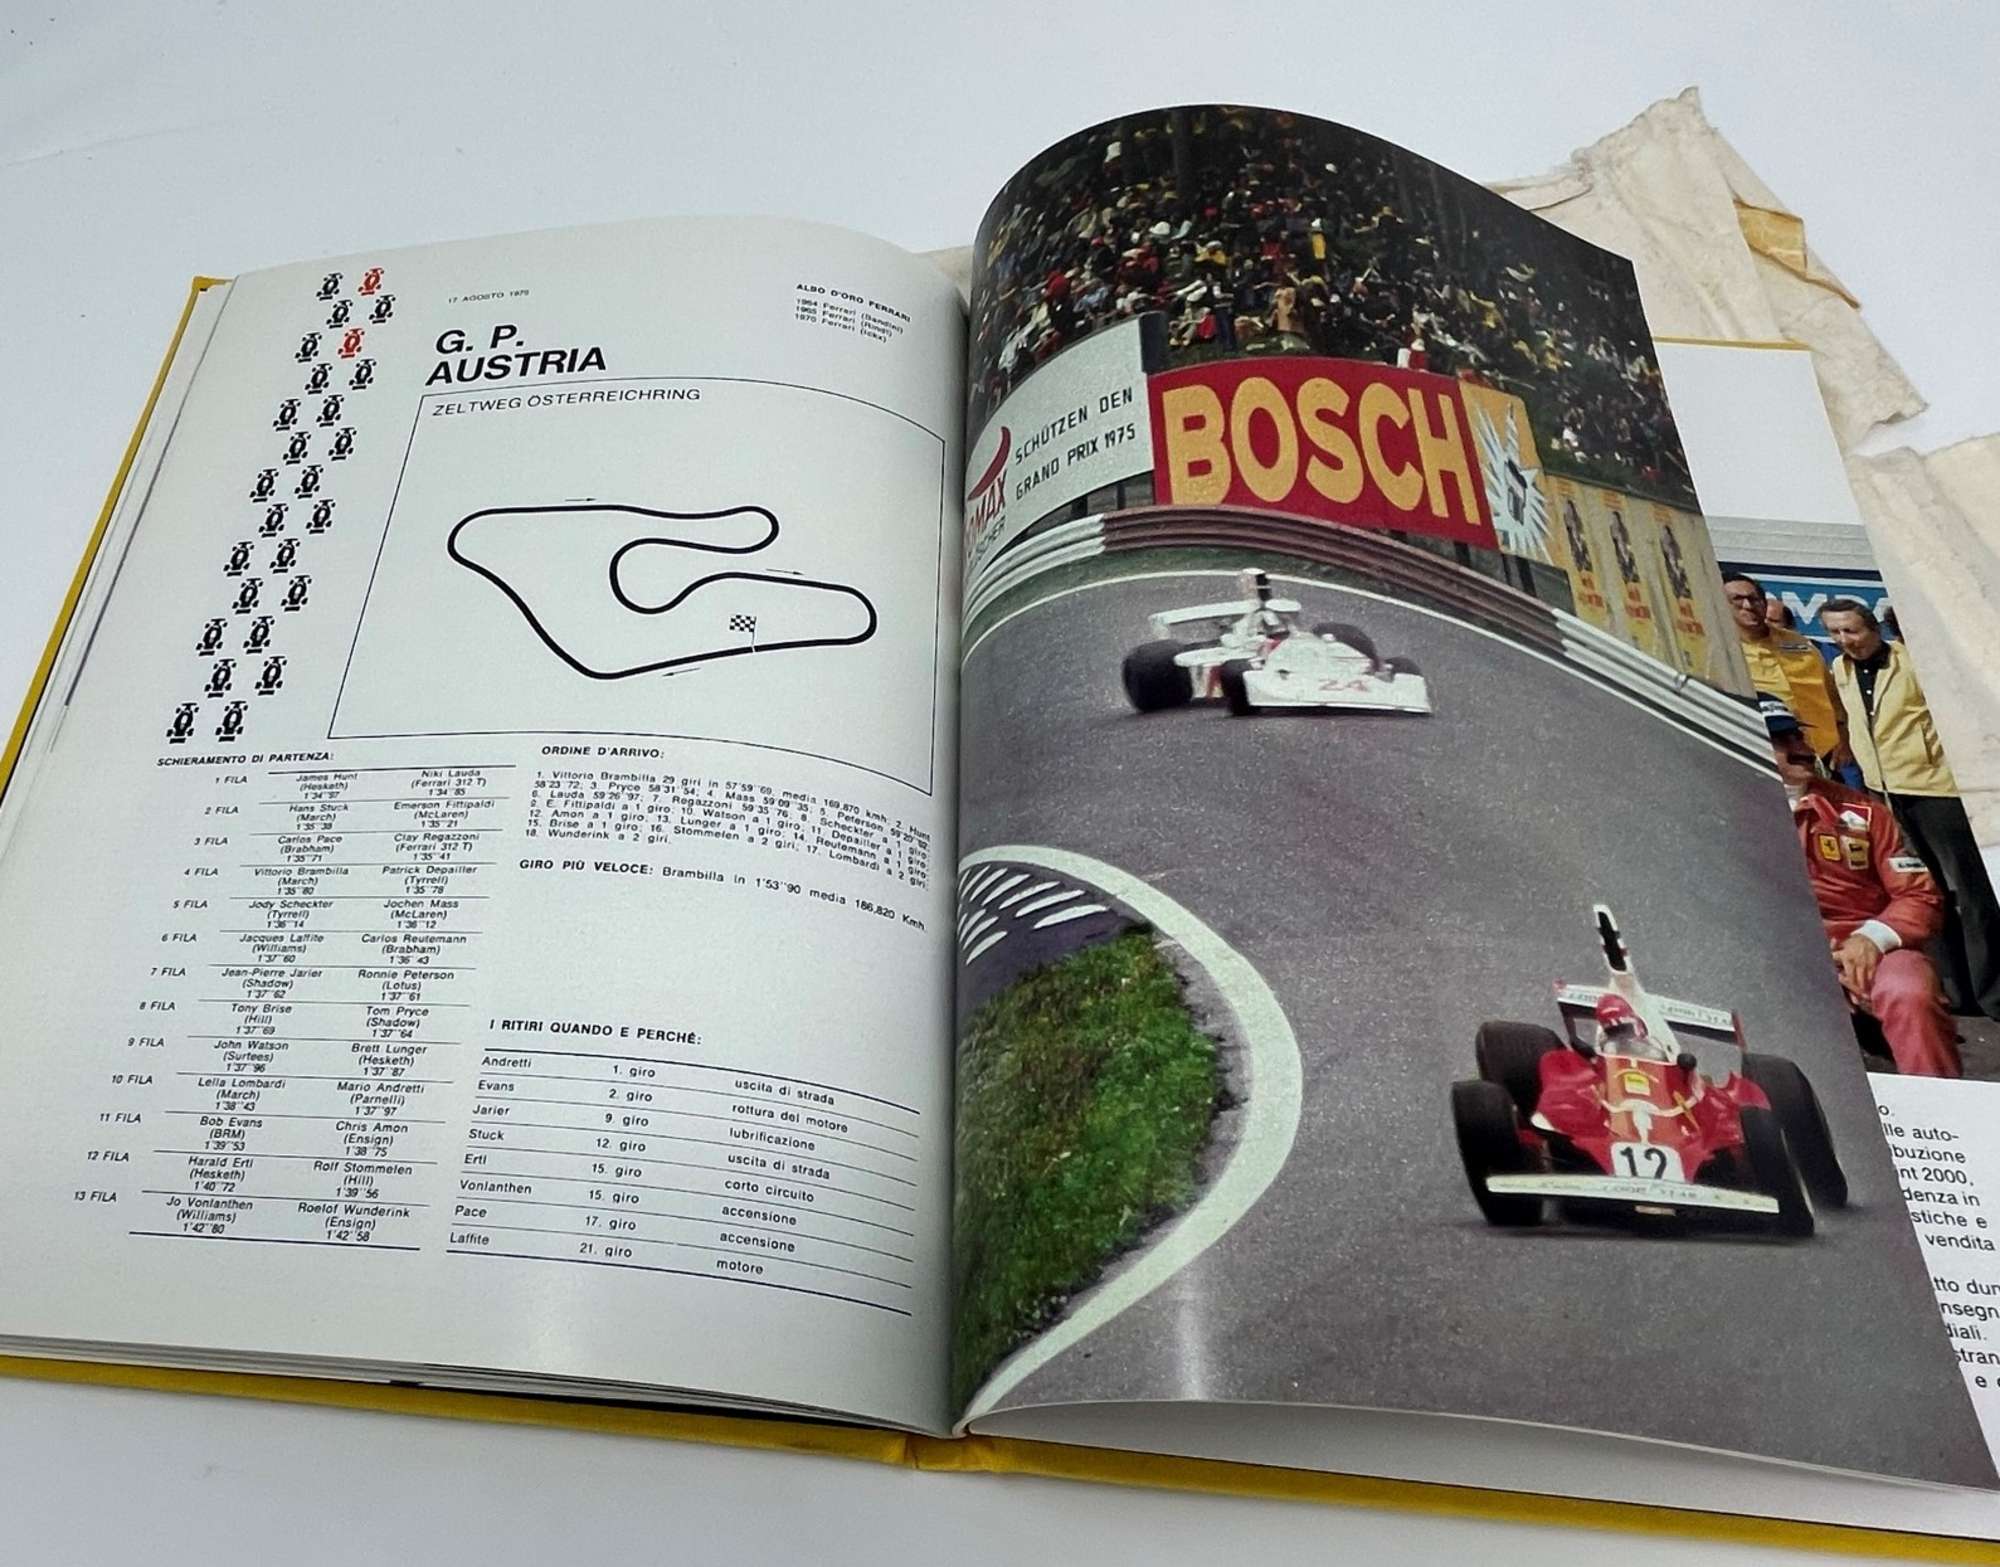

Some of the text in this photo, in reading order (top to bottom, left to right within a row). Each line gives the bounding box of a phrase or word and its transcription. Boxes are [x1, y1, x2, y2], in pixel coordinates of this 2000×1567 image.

[796, 284, 826, 294] ALBO
[869, 300, 910, 323] FERRARI
[436, 324, 524, 354] G. P.
[425, 346, 606, 386] AUSTRIA
[432, 389, 700, 416] ZELTWEG ÖSTERREICHRING
[1015, 386, 1134, 465] SCHÜTZEN DEN
[1162, 376, 1481, 526] BOSCH
[1016, 422, 1135, 500] GRAND PRIX 1975
[541, 746, 664, 758] ORDINE D'ARRIVO:
[157, 752, 333, 766] SCHIERAMENTO DI PARTENZA:
[224, 776, 247, 784] FILA
[204, 806, 238, 815] 2 FILA
[194, 837, 228, 845] 3 FILA
[194, 868, 218, 876] FILA
[519, 859, 554, 872] GIRO
[594, 861, 653, 875] VELOCE:
[662, 866, 724, 882] Brambilla
[734, 875, 745, 884] in
[809, 886, 846, 904] media
[183, 900, 208, 909] FILA
[161, 933, 197, 943] 6 FILA
[151, 967, 186, 977] 7 FILA
[139, 1001, 175, 1011] 8 FILA
[232, 1003, 292, 1015] Tony Brise
[366, 1006, 429, 1018] Tom Pryce
[490, 1019, 495, 1029] I
[502, 1020, 543, 1031] RITIRI
[550, 1022, 613, 1036] QUANDO
[620, 1027, 629, 1037] E
[128, 1037, 164, 1047] 9 FILA
[214, 1040, 289, 1050] John Watson
[351, 1043, 428, 1056] Brett Lunger
[481, 1056, 531, 1068] Andretti
[629, 1067, 655, 1078] giro
[112, 1074, 152, 1085] 10 FILA
[231, 1078, 286, 1089] Lombardi
[478, 1079, 514, 1091] Evans
[337, 1081, 424, 1093] Mario Andretti
[735, 1077, 834, 1105] uscita di strada
[626, 1091, 653, 1102] giro
[472, 1104, 510, 1116] Jarier
[100, 1113, 141, 1123] 11 FILA
[200, 1116, 263, 1128] Bob Evans
[622, 1115, 649, 1127] giro
[732, 1105, 848, 1133] rottura del motore
[336, 1120, 408, 1133] Chris Amon
[209, 1128, 245, 1140] (BRM)
[468, 1128, 504, 1140] Stuck
[730, 1127, 815, 1151] lubrificazione
[1912, 1128, 1959, 1142] auto-
[619, 1141, 646, 1152] giro
[88, 1151, 129, 1162] 12 FILA
[188, 1156, 253, 1168] Harald Ertl
[464, 1153, 487, 1165] Ertl
[1620, 1146, 1667, 1179] 12
[313, 1160, 412, 1175] Rolf Stommelen
[615, 1164, 642, 1178] giro
[728, 1152, 830, 1180] uscita di strada
[189, 1168, 245, 1182] (Hesketh)
[1900, 1167, 1918, 1180] nt
[343, 1175, 374, 1187] (Hill)
[460, 1179, 532, 1194] Vonlanthen
[75, 1191, 117, 1202] 13 FILA
[725, 1178, 814, 1202] corto circuito
[166, 1196, 253, 1210] Jo Vonlanthen
[612, 1192, 639, 1204] giro
[1962, 1191, 1980, 1206] in
[298, 1202, 410, 1217] Roelof Wunderink
[455, 1205, 487, 1218] Pace
[722, 1204, 797, 1226] accensione
[609, 1218, 636, 1231] giro
[1911, 1210, 1987, 1229] stiche e
[450, 1232, 489, 1245] Laffite
[720, 1233, 795, 1252] accensione
[1924, 1234, 1995, 1251] vendita
[605, 1246, 632, 1258] giro
[716, 1256, 763, 1275] motore
[1933, 1277, 1960, 1292] tto
[1975, 1376, 1987, 1388] e
